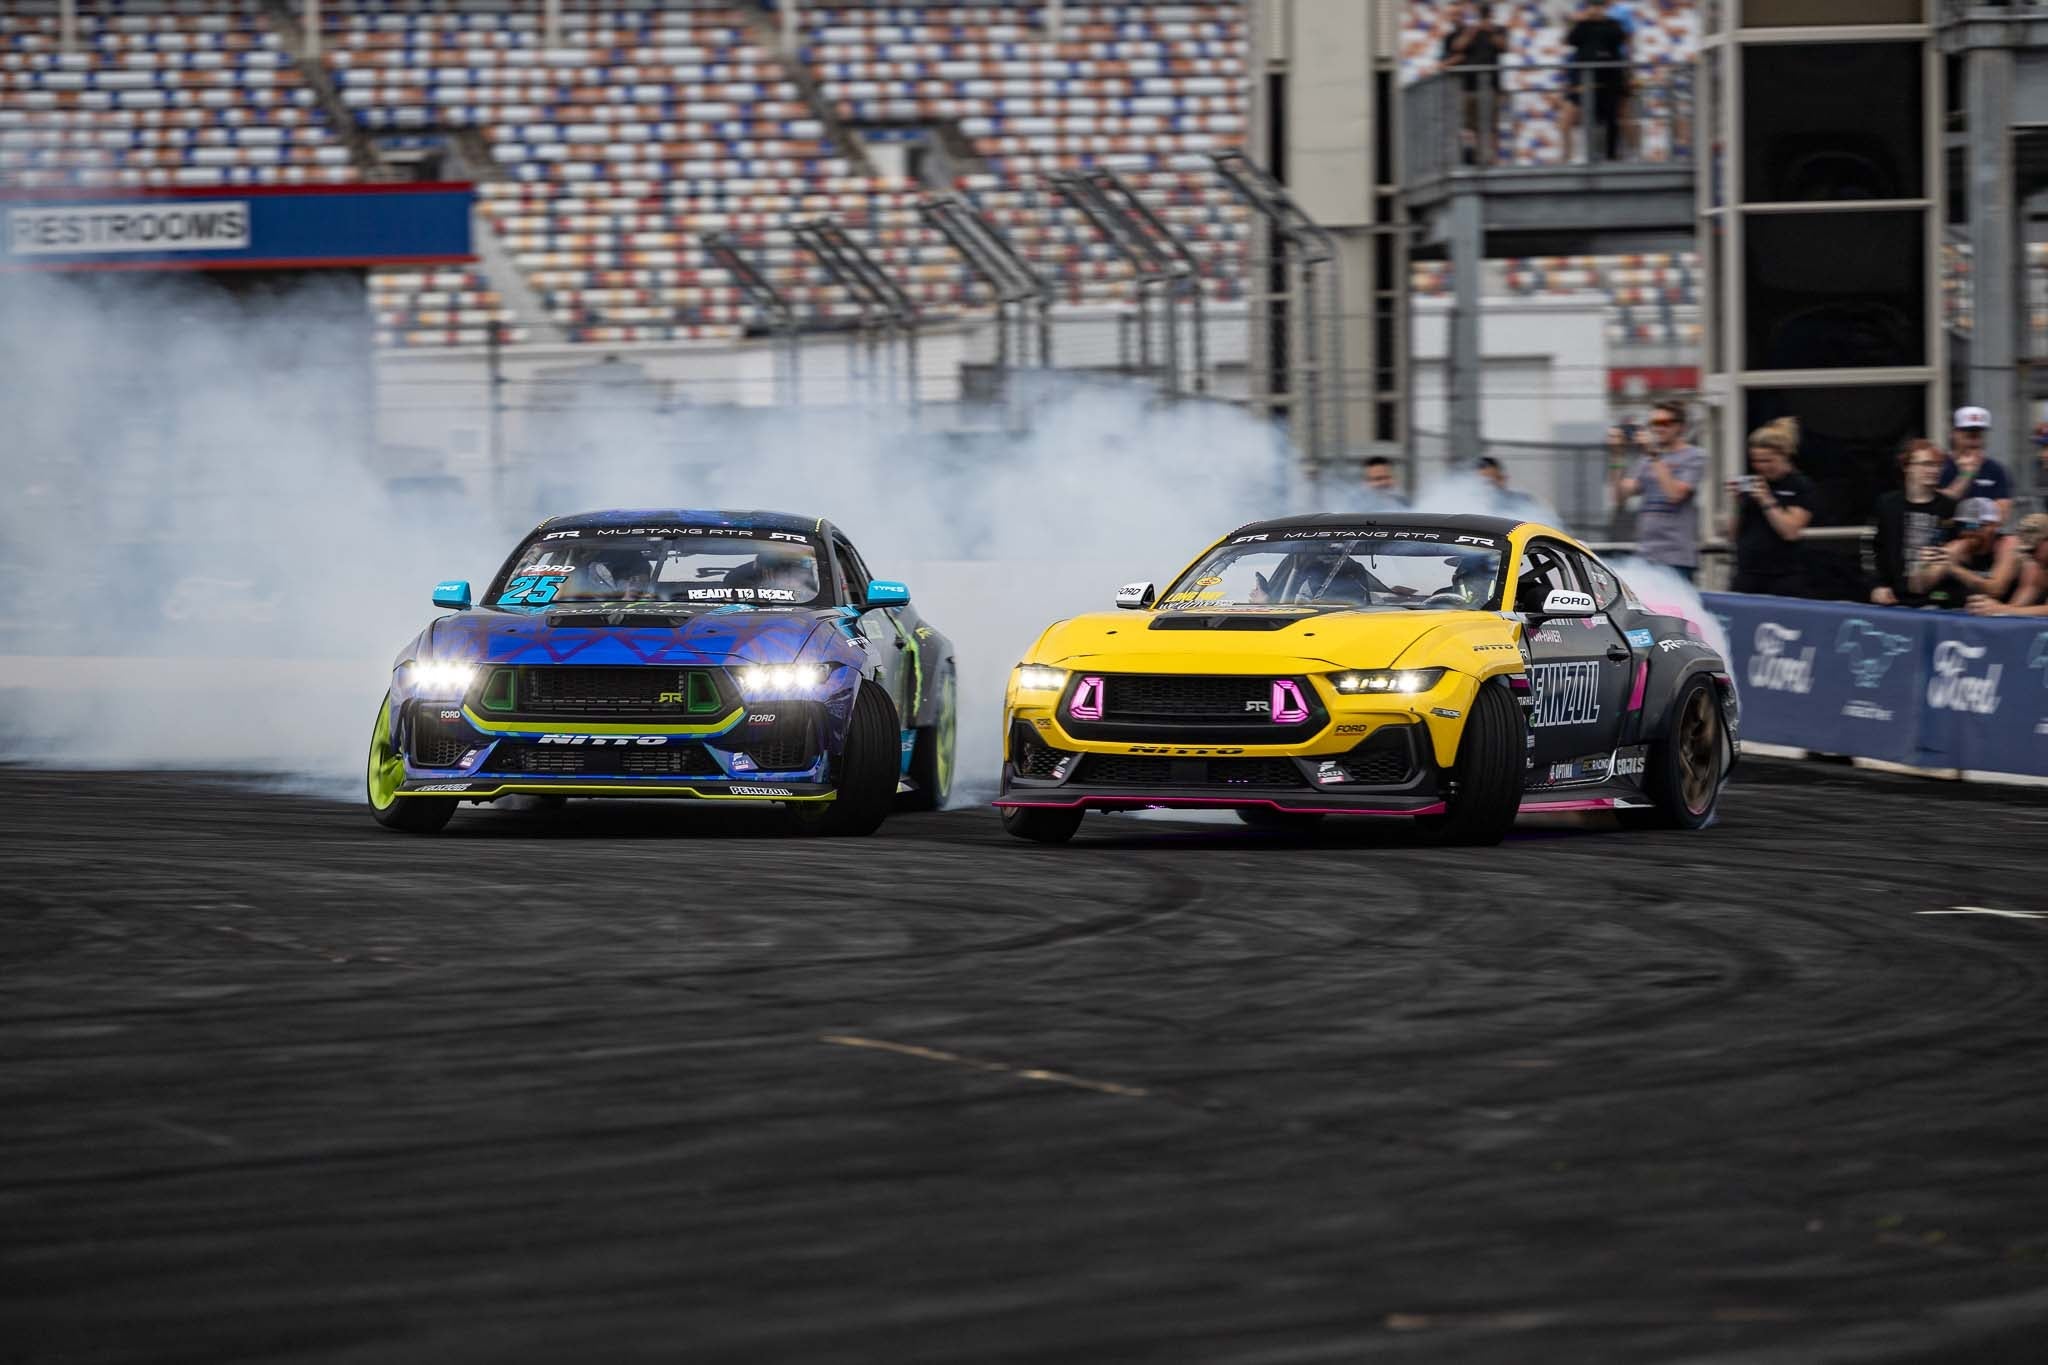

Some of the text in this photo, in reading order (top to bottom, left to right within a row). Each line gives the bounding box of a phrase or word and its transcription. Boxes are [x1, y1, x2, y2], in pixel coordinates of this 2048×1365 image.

[12, 211, 246, 245] RESTROOMS
[1394, 532, 1440, 540] RTR
[523, 564, 576, 573] FORD
[496, 575, 568, 606] 25
[688, 588, 795, 601] READY TO ROCK
[1550, 596, 1591, 606] FORD
[1472, 644, 1513, 652] NITTO
[440, 710, 460, 719] FORD
[748, 714, 776, 722] FORD
[1335, 724, 1367, 733] FORD
[537, 734, 669, 745] NITTO
[1127, 745, 1245, 755] NITTO
[729, 786, 793, 796] PENNZOIL
